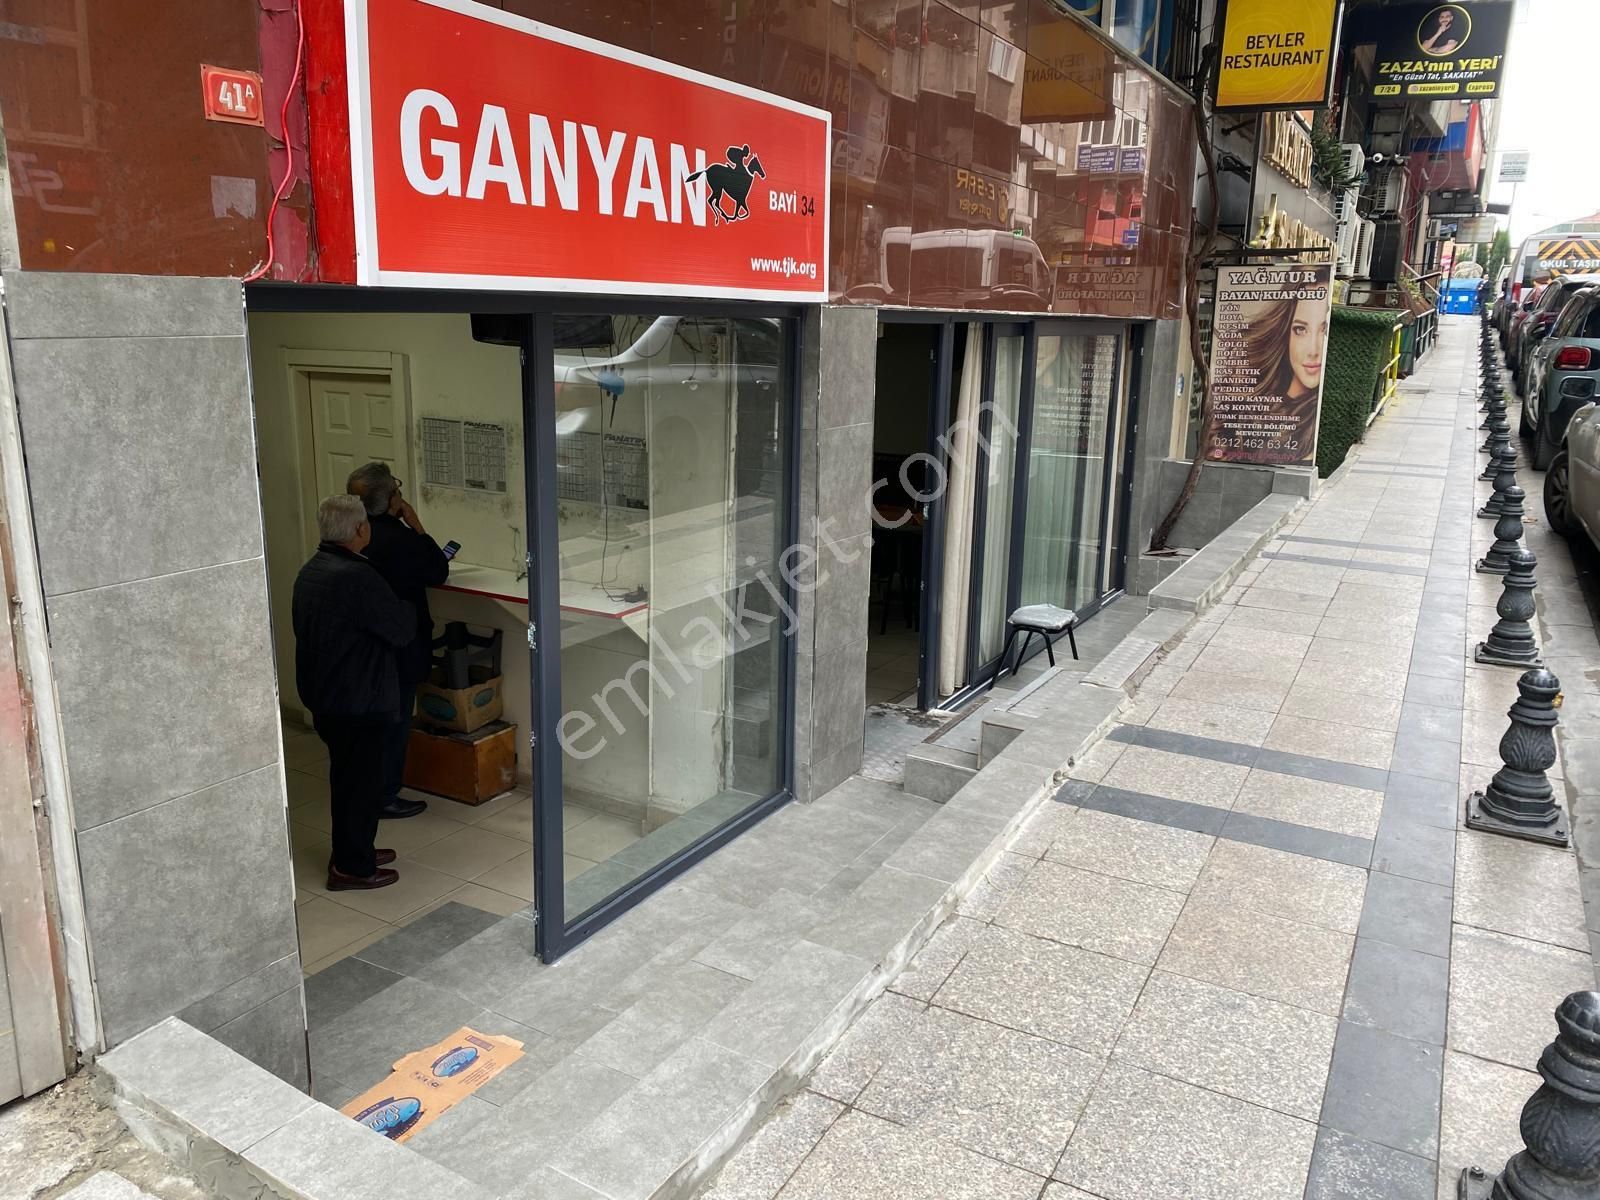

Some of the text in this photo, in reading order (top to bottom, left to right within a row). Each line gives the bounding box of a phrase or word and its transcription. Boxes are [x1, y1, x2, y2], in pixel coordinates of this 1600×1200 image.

[1246, 32, 1305, 49] BEYLER
[1223, 50, 1324, 69] RESTAURANT
[1459, 56, 1499, 71] YERİ
[400, 88, 707, 227] GANYAN
[769, 189, 815, 217] BAYİ 34
[751, 256, 817, 280] www.tjk.org
[1540, 259, 1569, 268] OKUL
[1229, 268, 1317, 284] YAĞMUR
[1220, 287, 1327, 301] BAYAN KUAFÖRÜ
[1220, 303, 1241, 312] FÖN
[1220, 313, 1244, 322] BOYA
[1246, 395, 1283, 403] KAYNAK
[1231, 403, 1270, 412] KONTÜR
[1214, 437, 1299, 450] 0212 462 63 42
